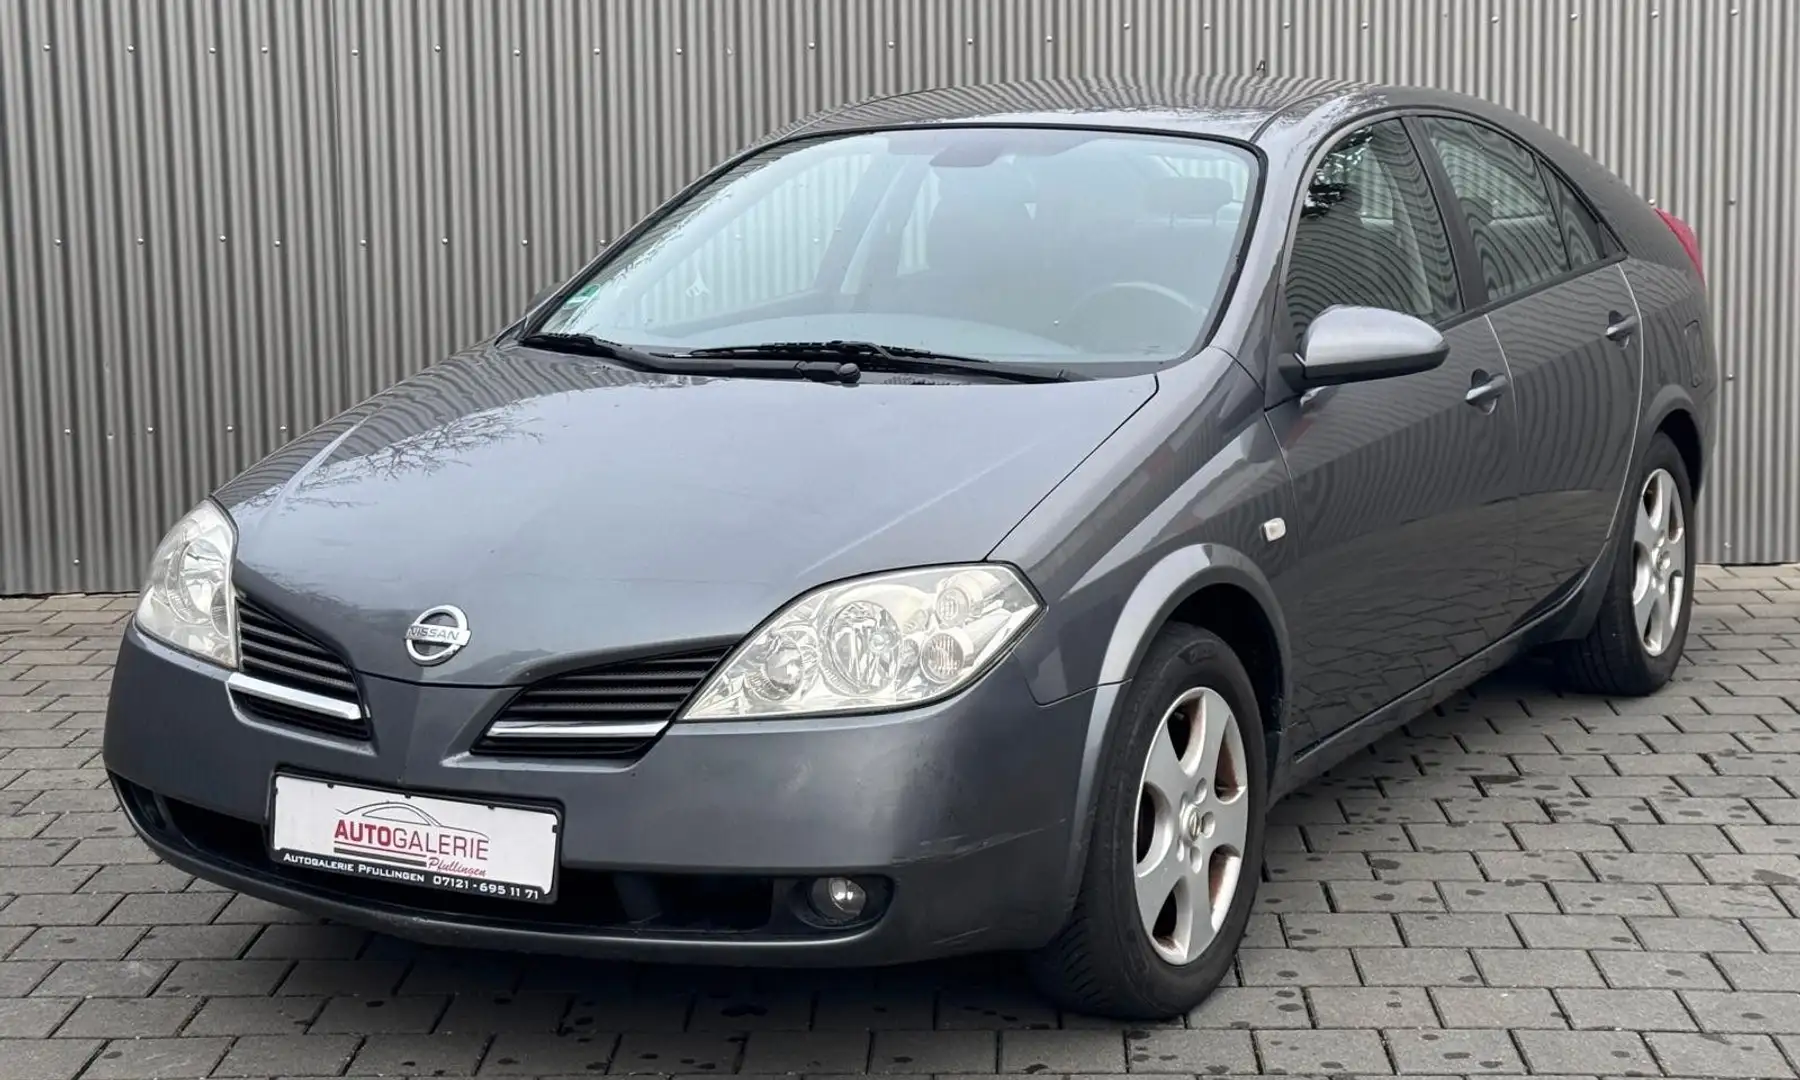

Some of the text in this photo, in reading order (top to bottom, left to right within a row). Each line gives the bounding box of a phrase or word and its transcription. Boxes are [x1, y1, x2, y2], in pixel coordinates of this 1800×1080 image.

[408, 626, 460, 640] NISSAN
[334, 819, 489, 861] AUTOGALERIE
[427, 857, 486, 876] Pfullingen
[433, 875, 469, 889] 07121
[479, 882, 505, 895] 695
[510, 886, 520, 897] 11
[525, 889, 538, 900] 71
